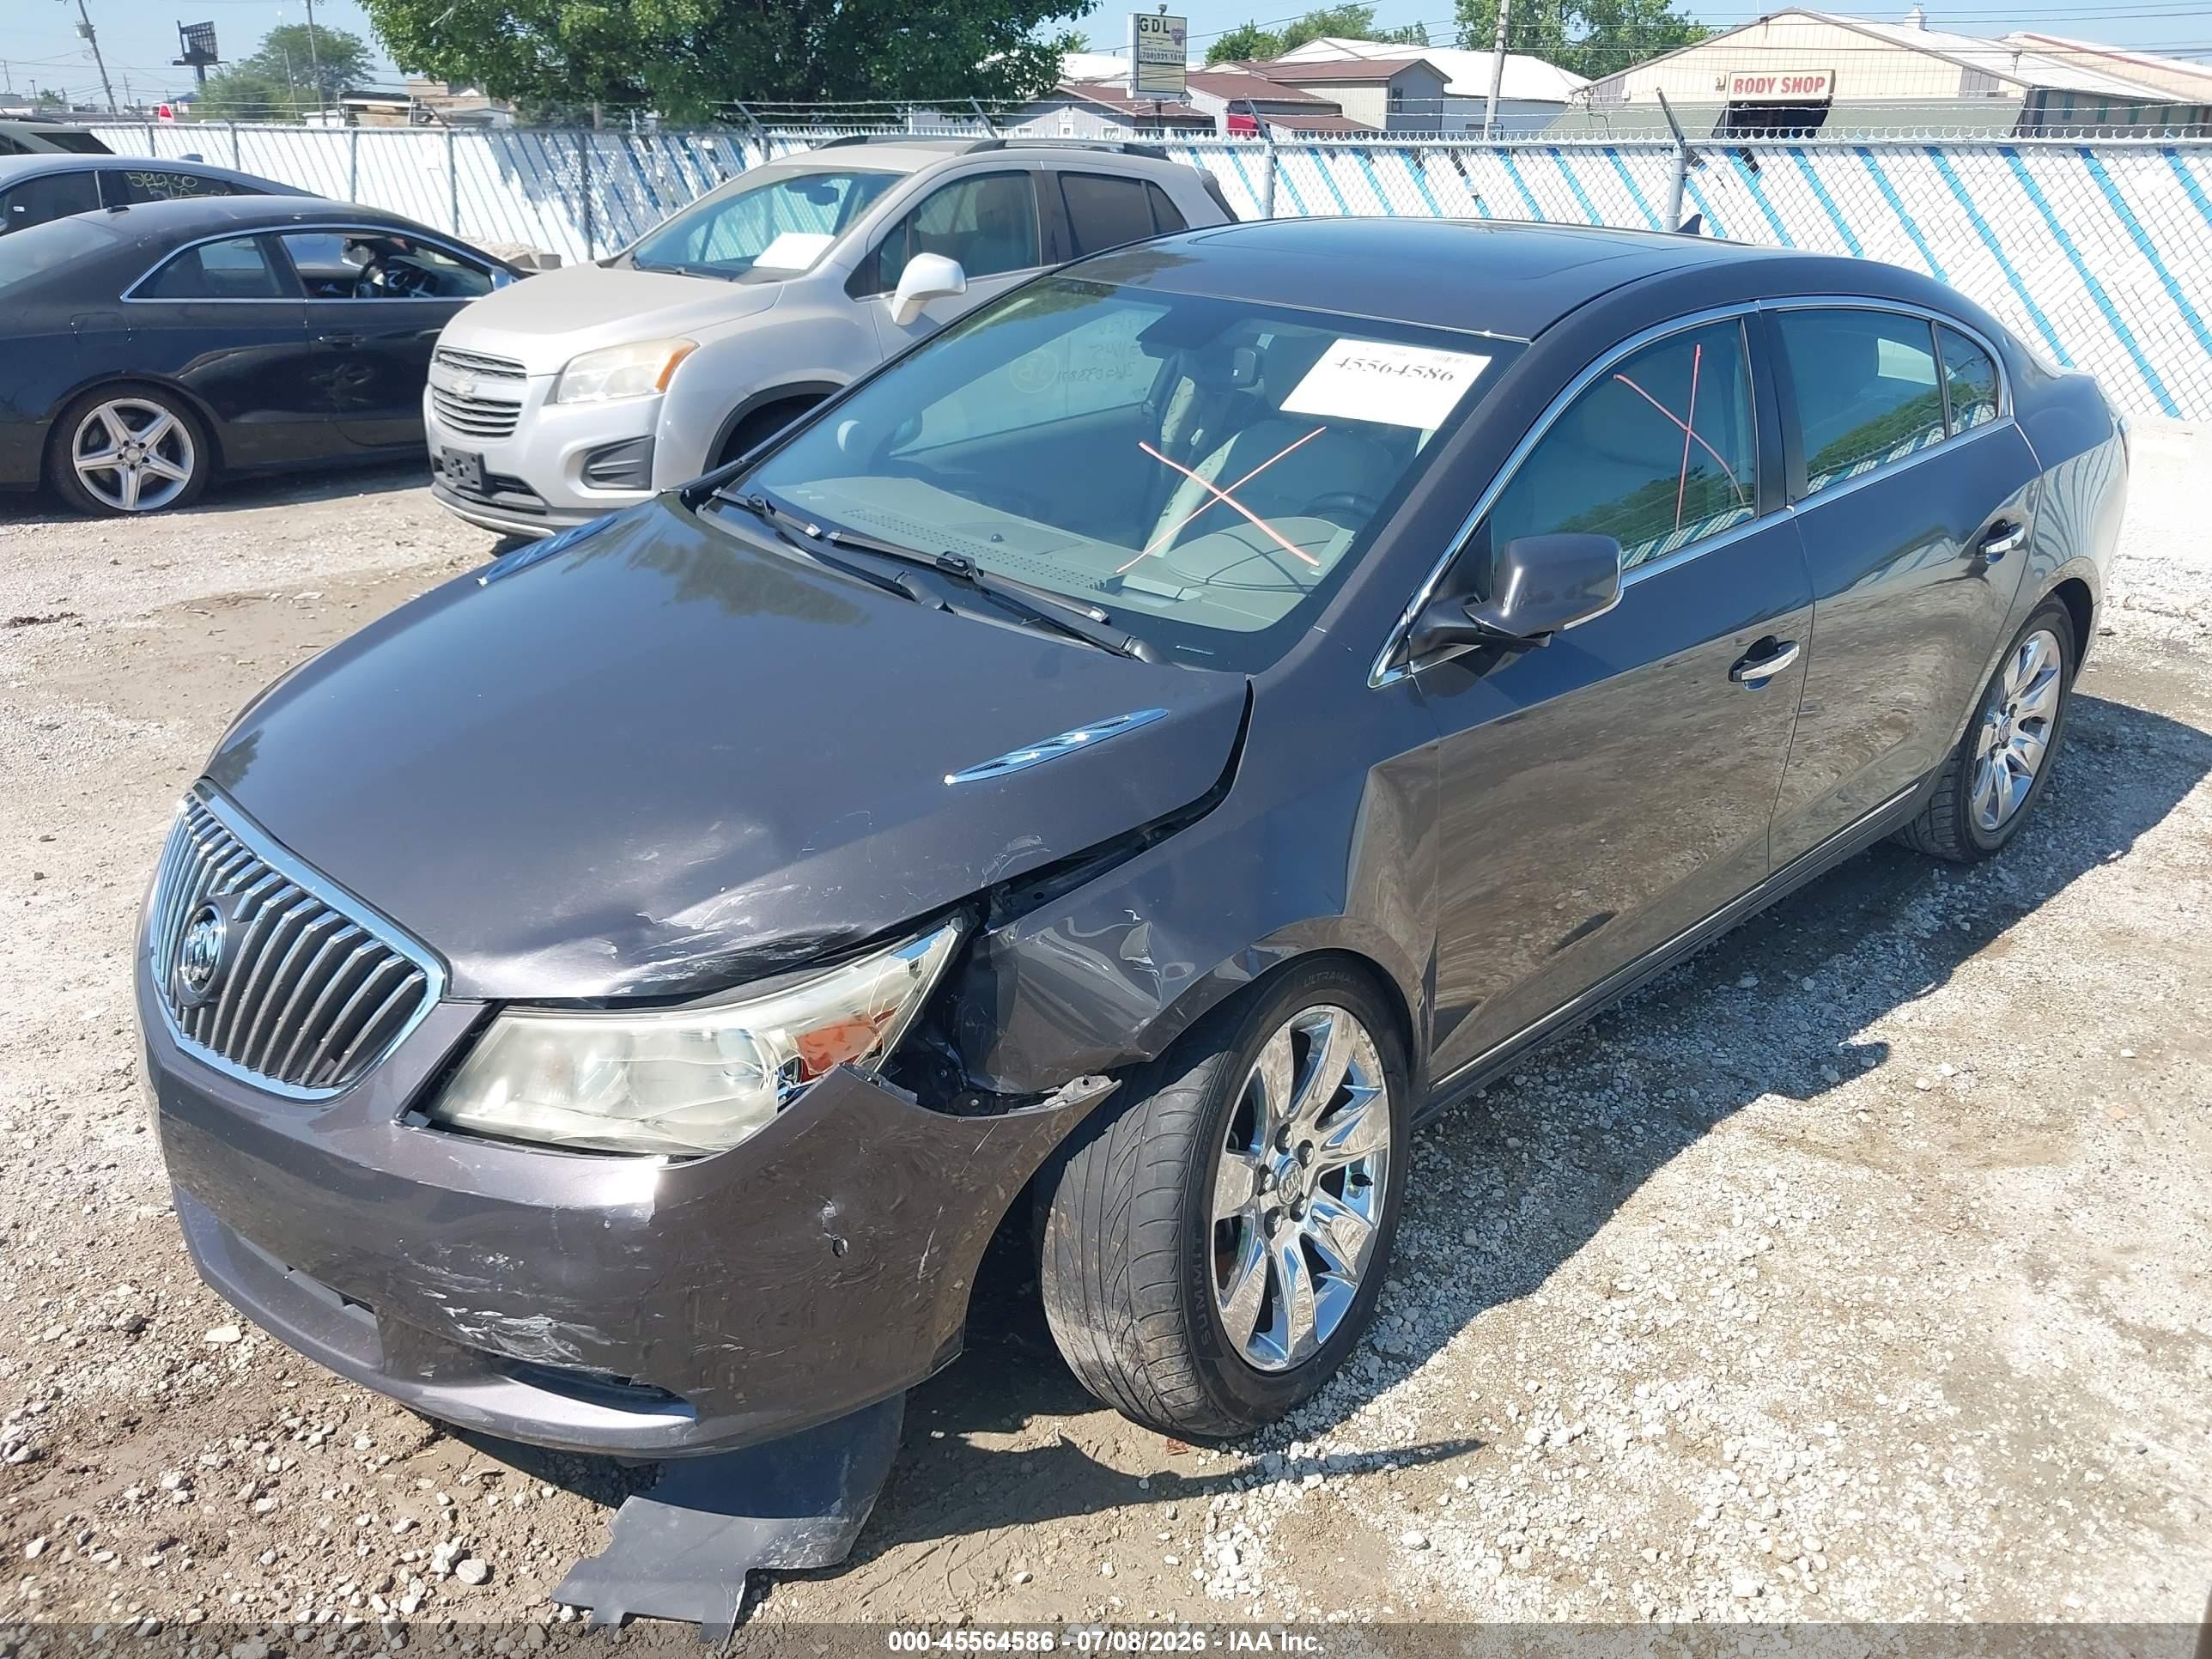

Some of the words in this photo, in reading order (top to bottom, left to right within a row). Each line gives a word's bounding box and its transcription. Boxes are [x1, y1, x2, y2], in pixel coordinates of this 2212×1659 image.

[1139, 17, 1170, 34] GDL
[1733, 76, 1777, 94] BODY
[1781, 76, 1826, 94] SHOP
